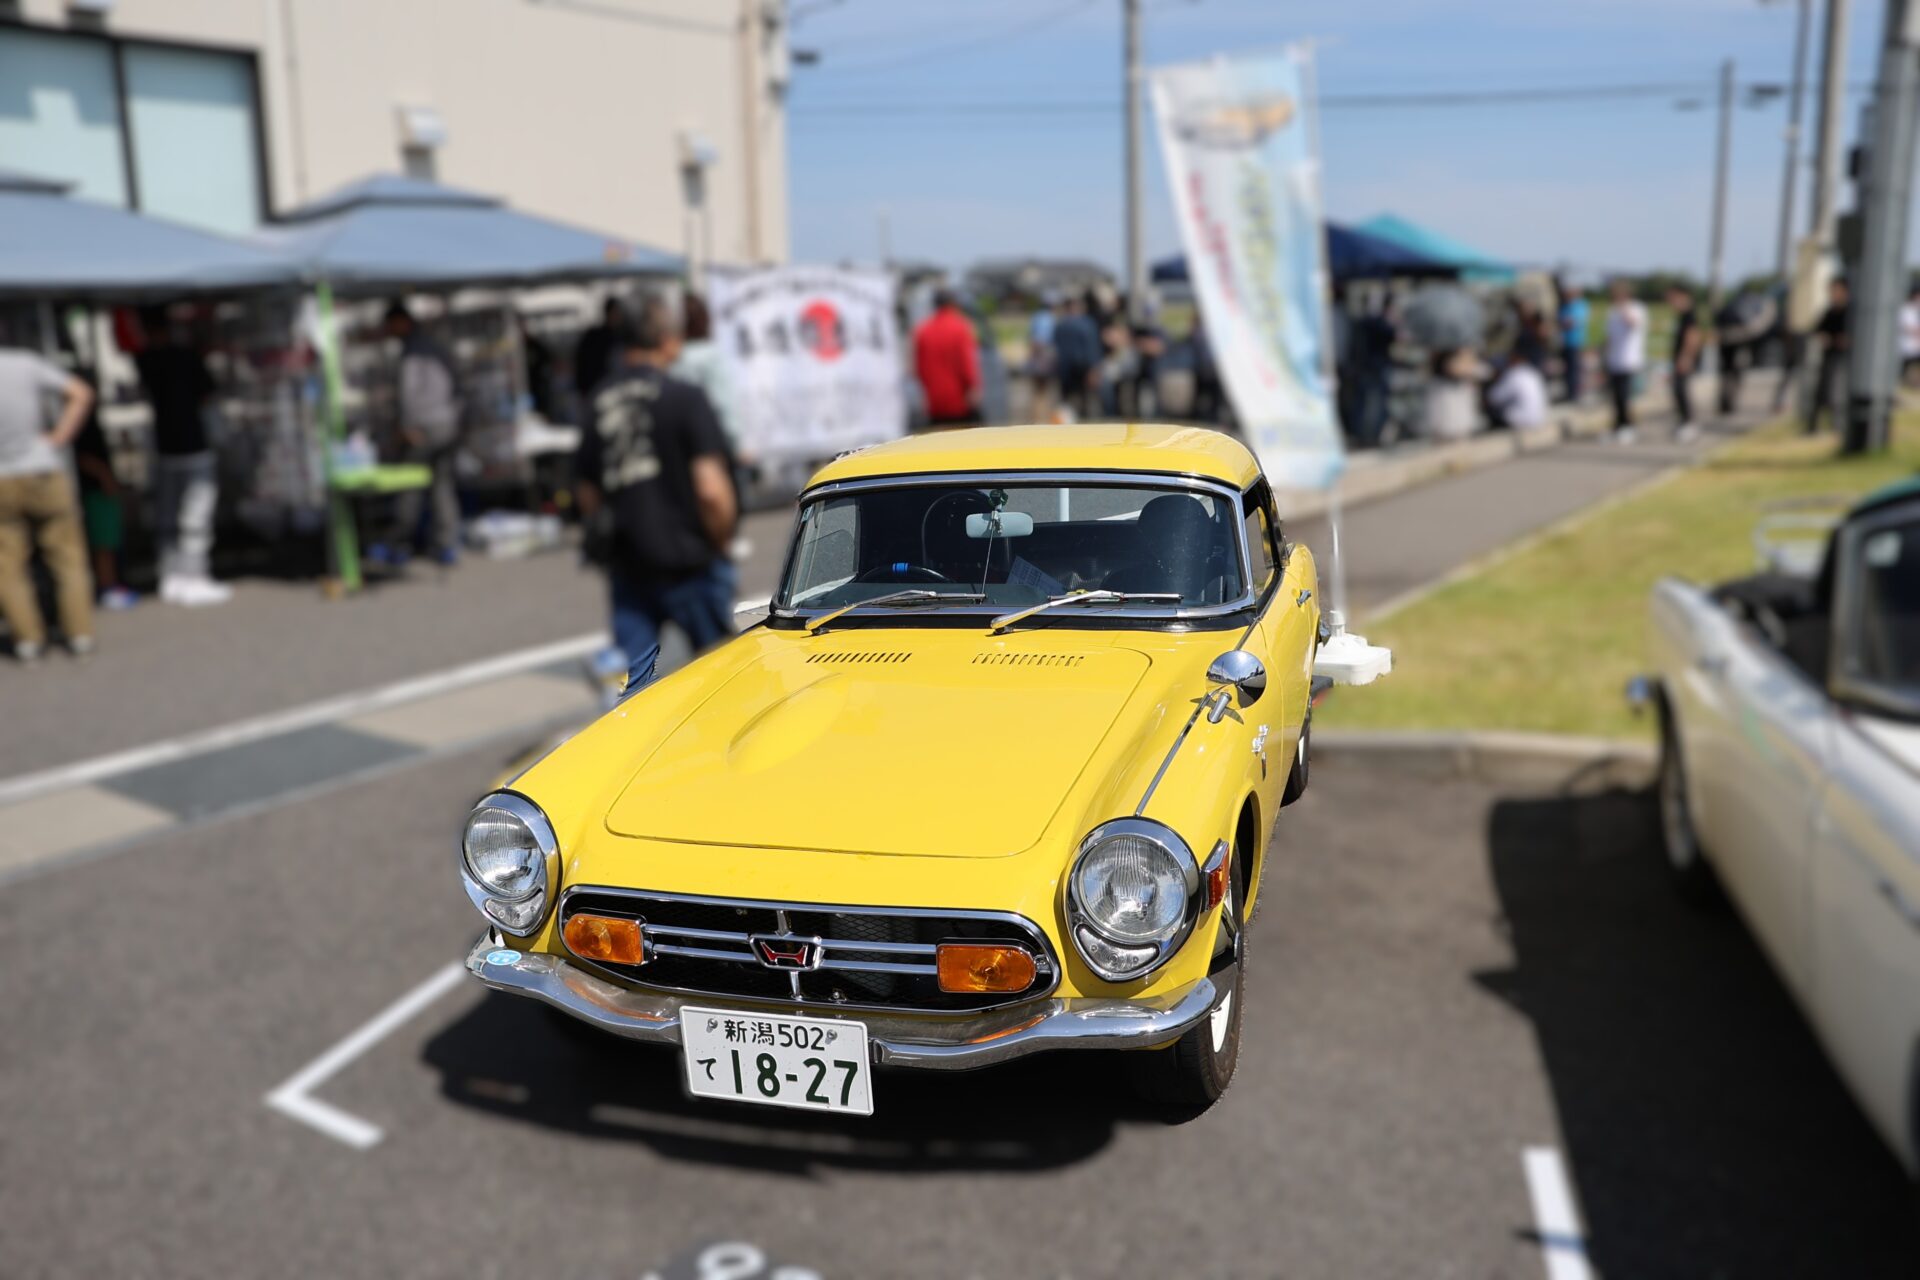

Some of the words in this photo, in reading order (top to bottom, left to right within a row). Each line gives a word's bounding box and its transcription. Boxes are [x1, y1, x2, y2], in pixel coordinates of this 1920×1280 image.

[724, 1019, 825, 1051] 新潟502
[696, 1058, 717, 1081] て
[731, 1049, 858, 1107] 18-27
